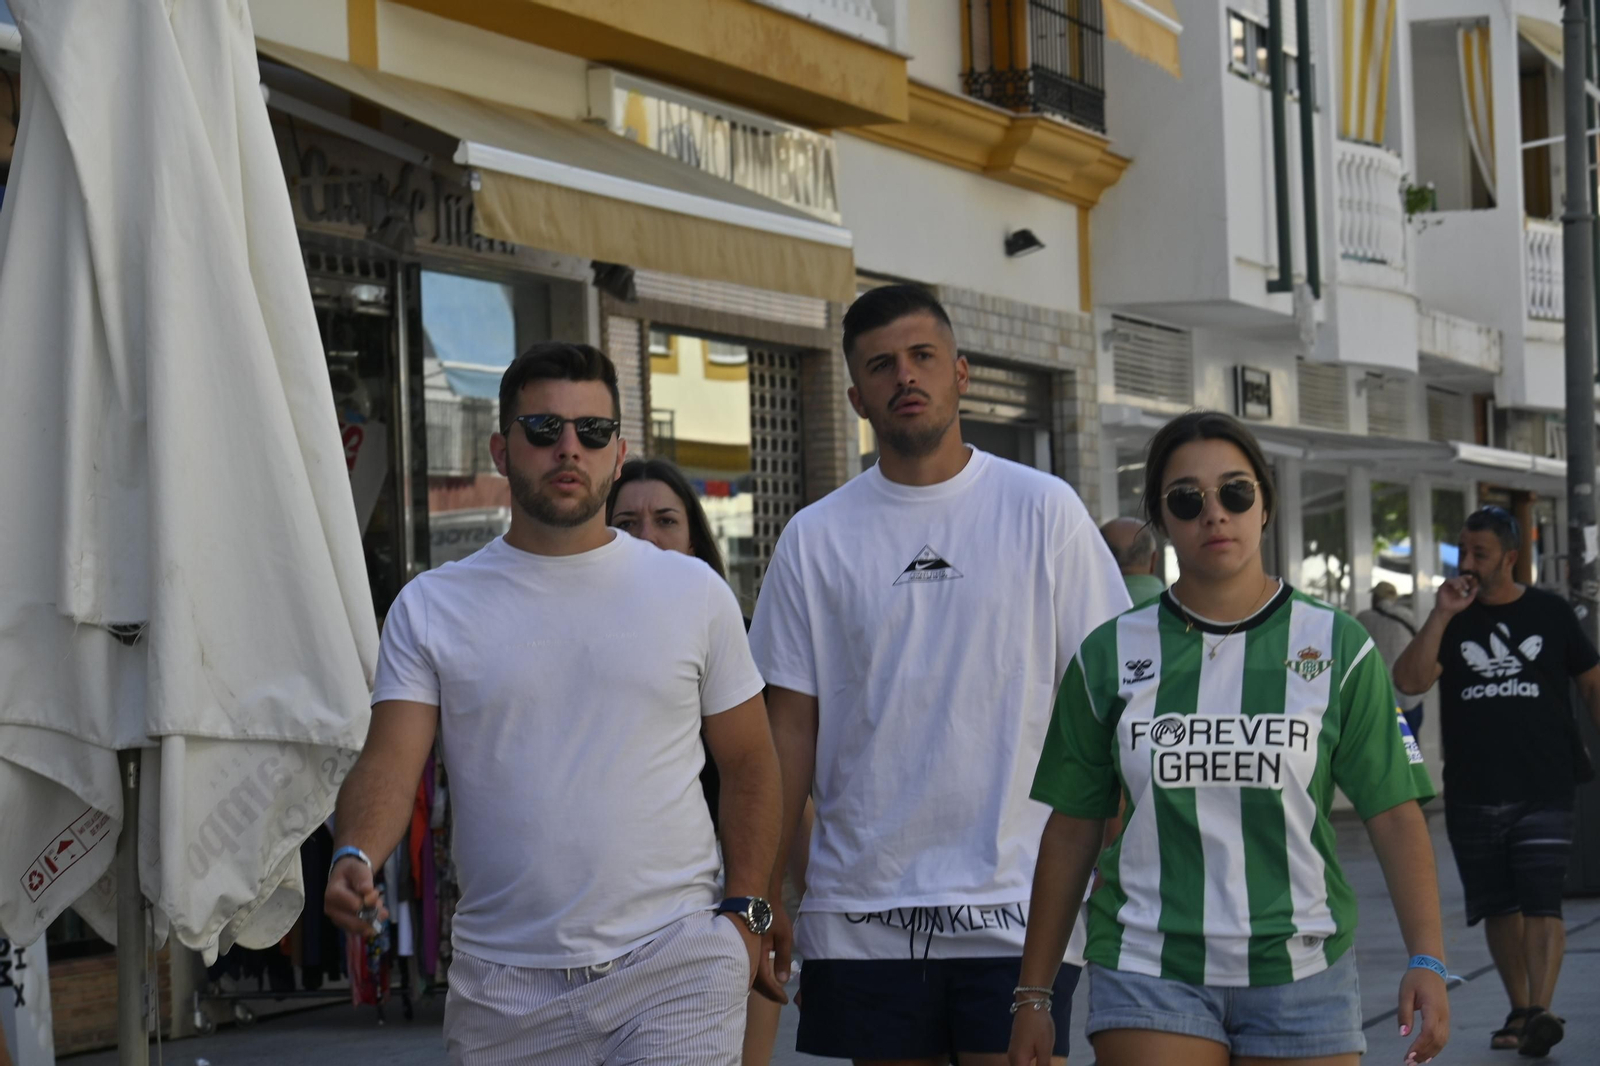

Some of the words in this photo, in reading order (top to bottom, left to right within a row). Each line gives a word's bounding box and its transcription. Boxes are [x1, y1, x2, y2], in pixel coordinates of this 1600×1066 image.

[1460, 678, 1540, 700] acedias
[1130, 716, 1310, 752] FOREVER
[1158, 750, 1281, 784] GREEN
[947, 902, 1027, 934] KLEIN
